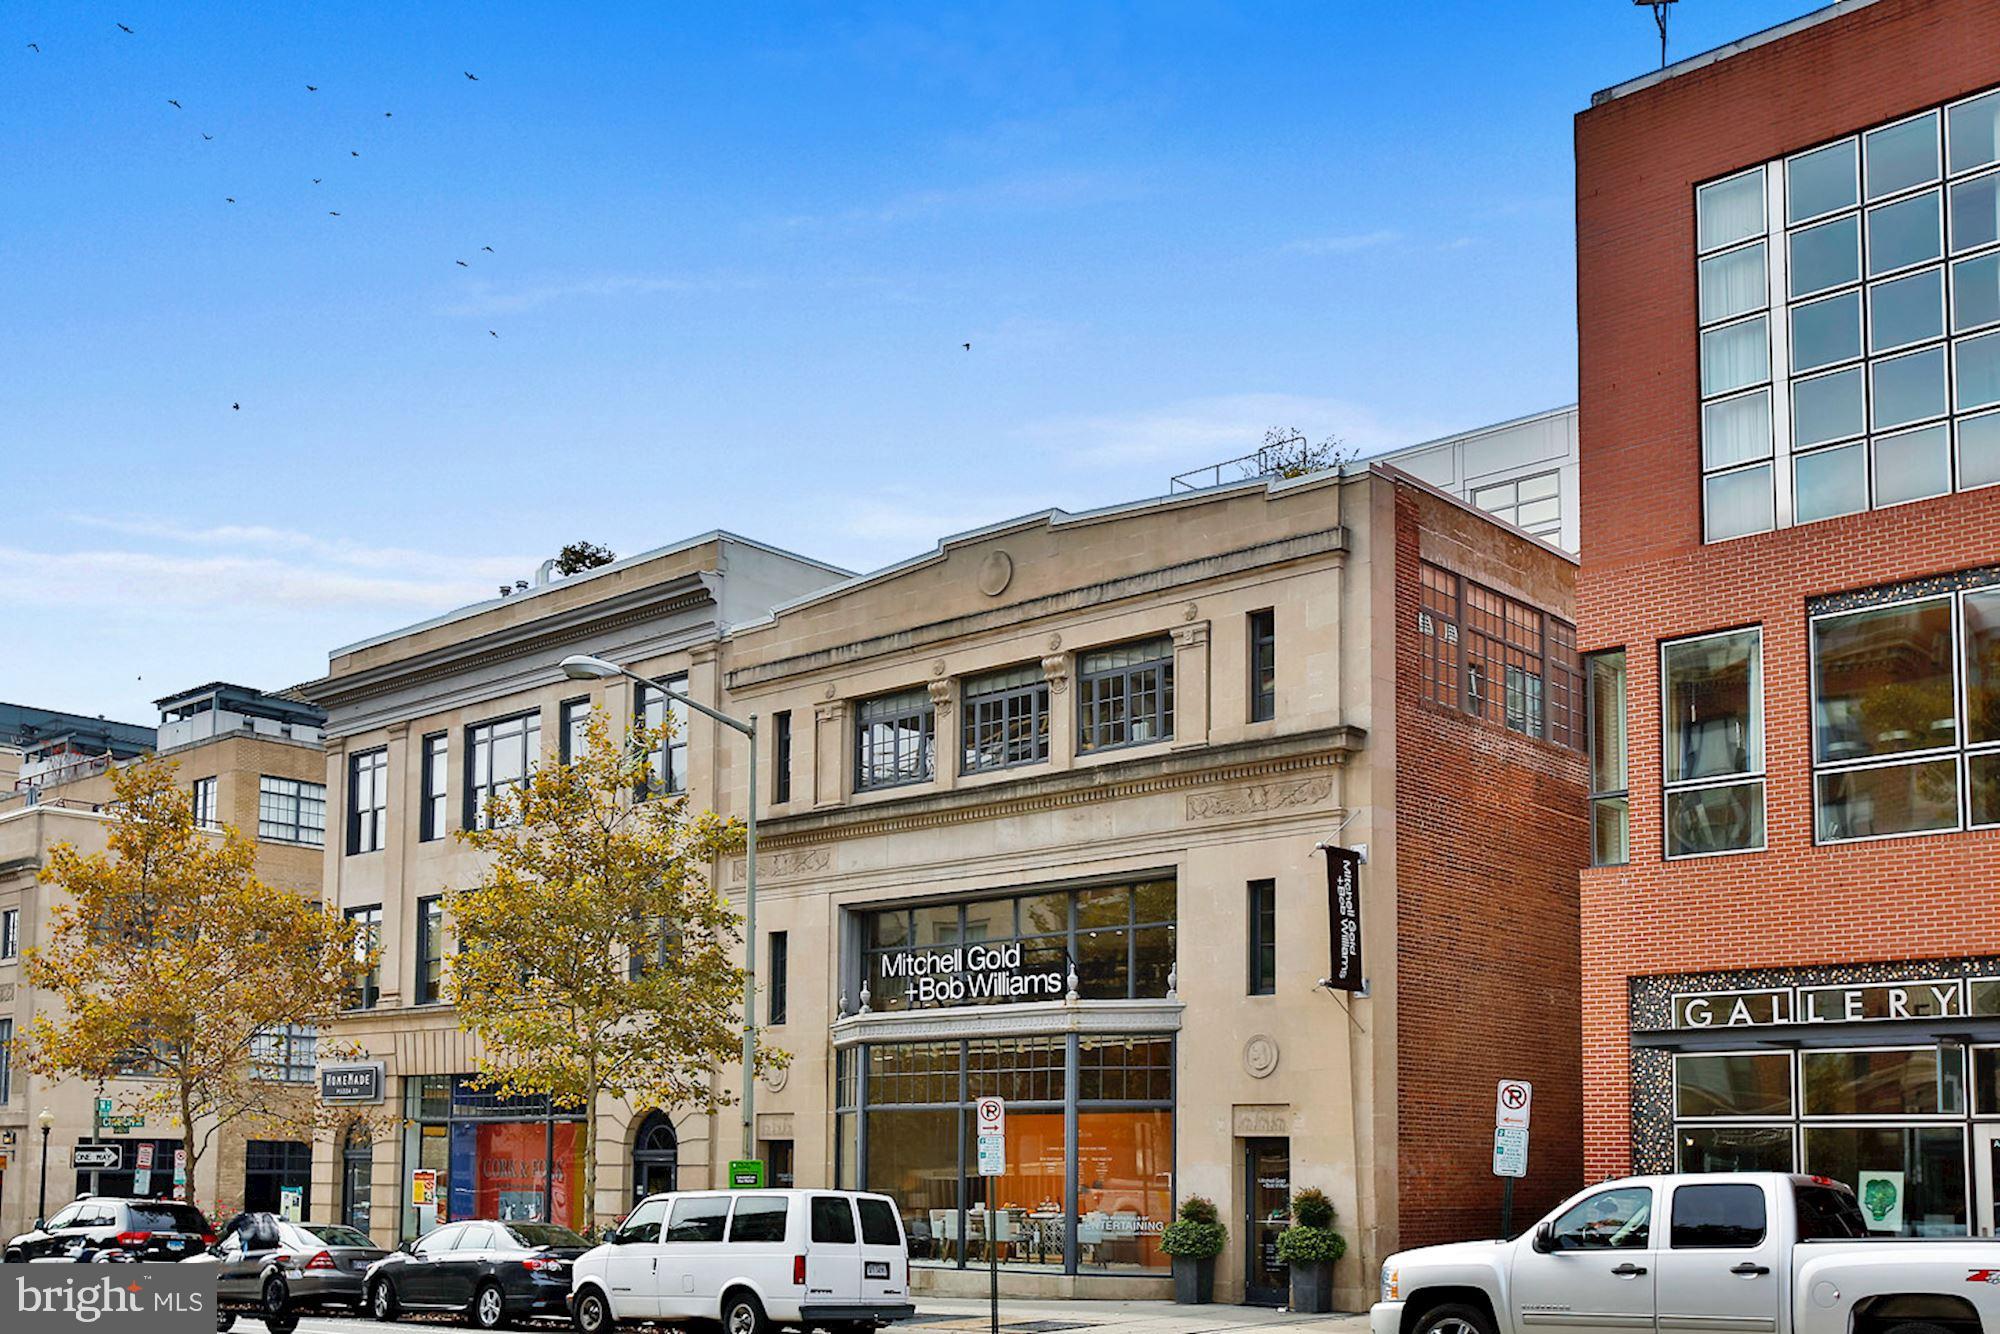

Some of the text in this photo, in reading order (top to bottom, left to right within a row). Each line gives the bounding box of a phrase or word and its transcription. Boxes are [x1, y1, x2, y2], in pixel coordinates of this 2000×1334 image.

[1342, 859, 1357, 956] Mitchell Gold
[1337, 875, 1349, 979] +Bob Williams
[881, 942, 1021, 978] Mitchell Gold
[904, 971, 1062, 1001] +Bob Williams
[1684, 985, 1957, 1027] GALLERY
[76, 1151, 112, 1161] ONE WAY
[532, 1158, 564, 1182] FOK
[1084, 1221, 1164, 1232] ENTERTAINING
